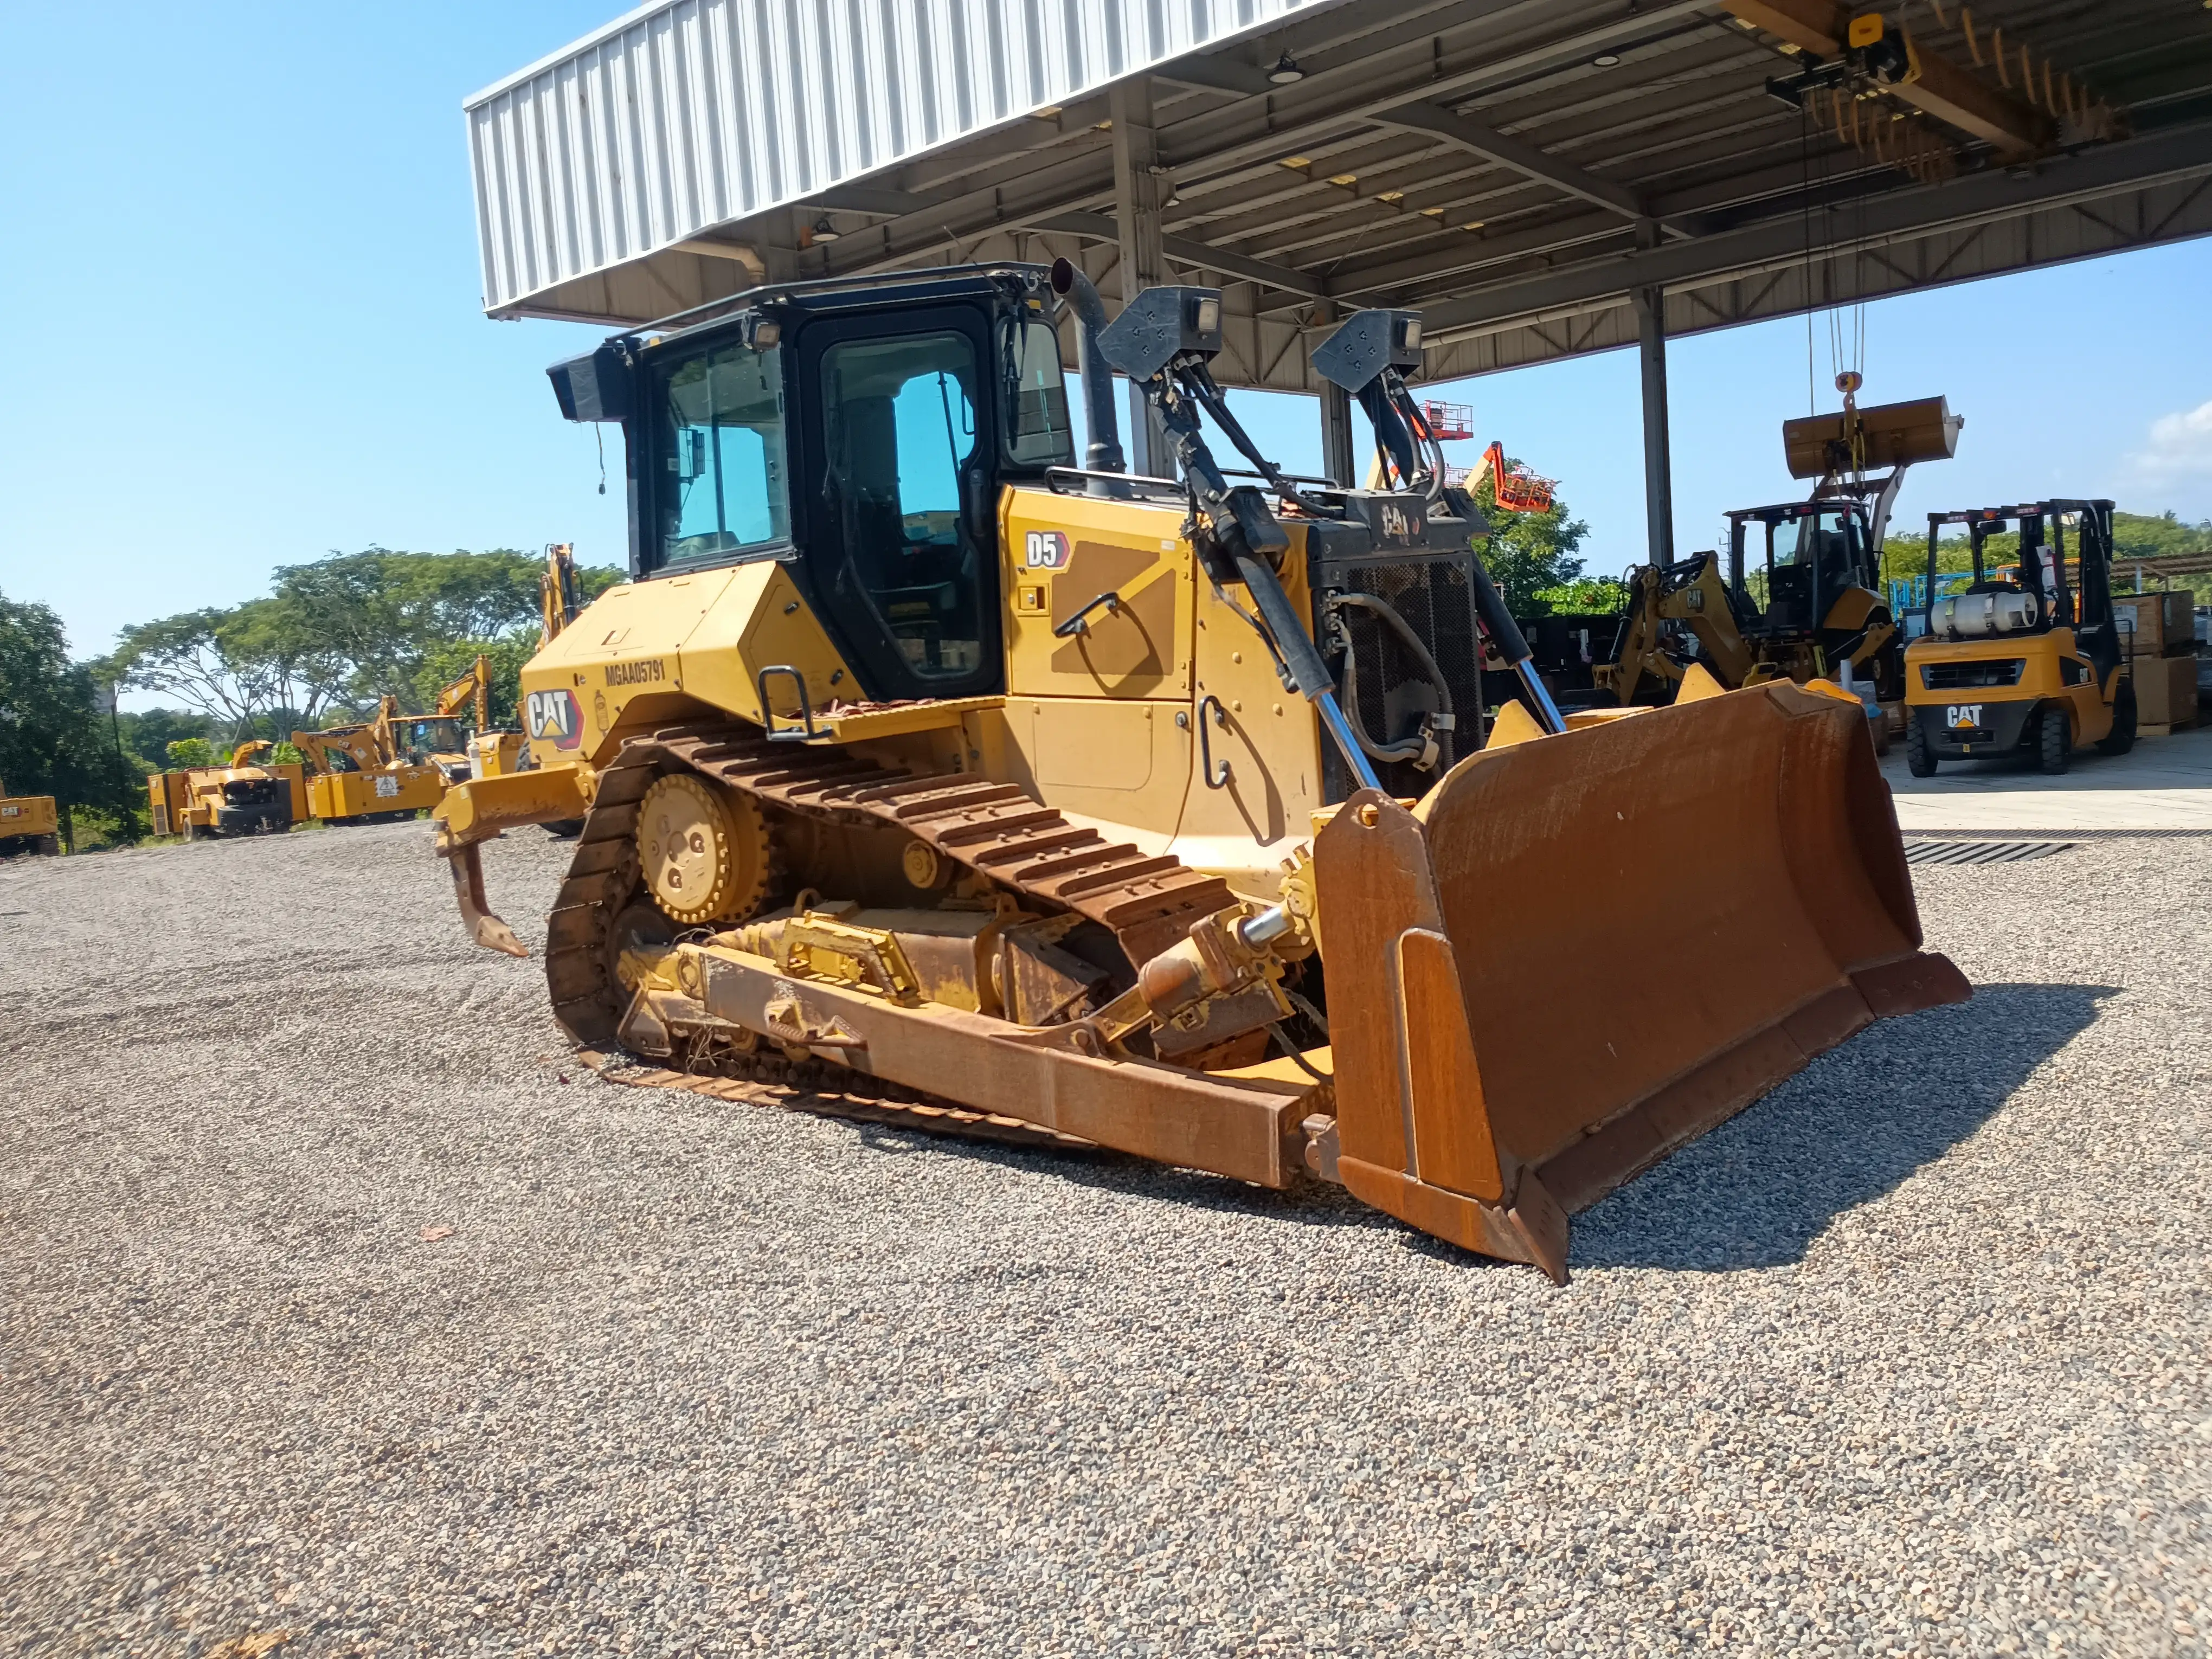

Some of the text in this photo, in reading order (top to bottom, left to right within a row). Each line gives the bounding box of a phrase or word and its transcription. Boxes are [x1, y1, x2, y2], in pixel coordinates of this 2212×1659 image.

[1027, 533, 1057, 565] D5
[1687, 590, 1701, 608] CAT
[605, 658, 666, 687] MGAA05791
[527, 691, 569, 737] CAT
[1947, 705, 1983, 728] CAT
